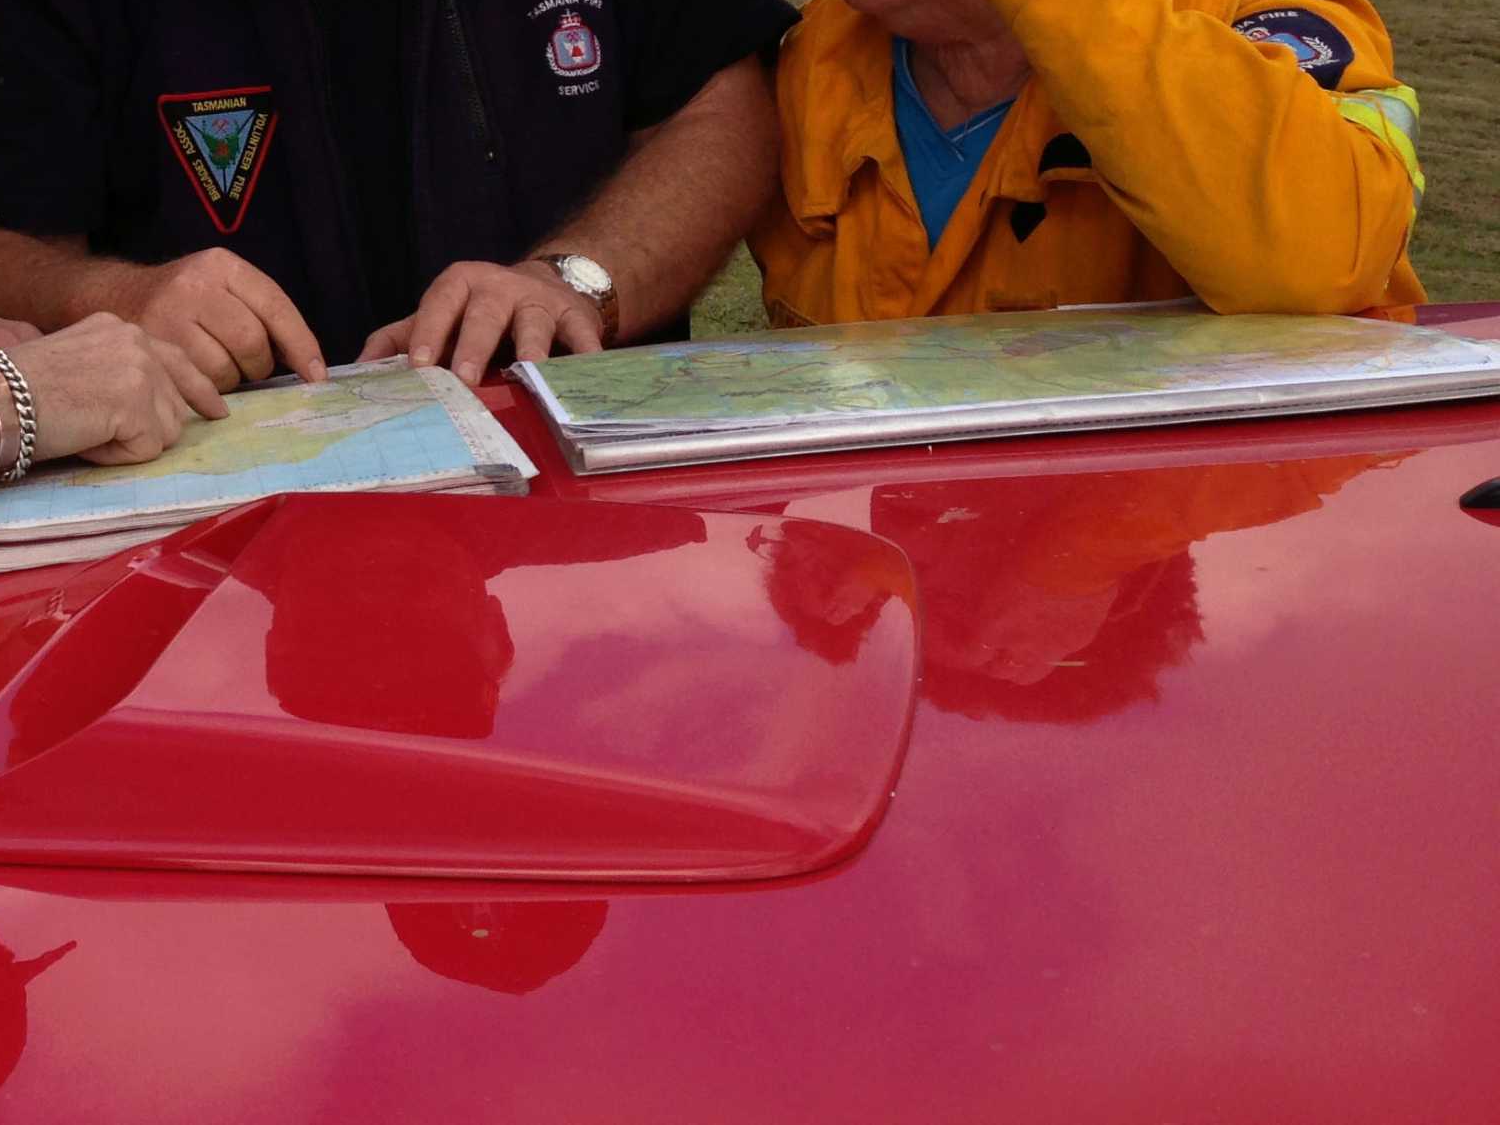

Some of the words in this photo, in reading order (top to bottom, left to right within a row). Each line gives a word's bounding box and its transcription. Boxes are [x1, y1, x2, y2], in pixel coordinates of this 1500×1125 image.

[1259, 10, 1300, 21] FIRE
[239, 113, 269, 172] VOLUNTEER
[228, 175, 246, 201] FIRE
